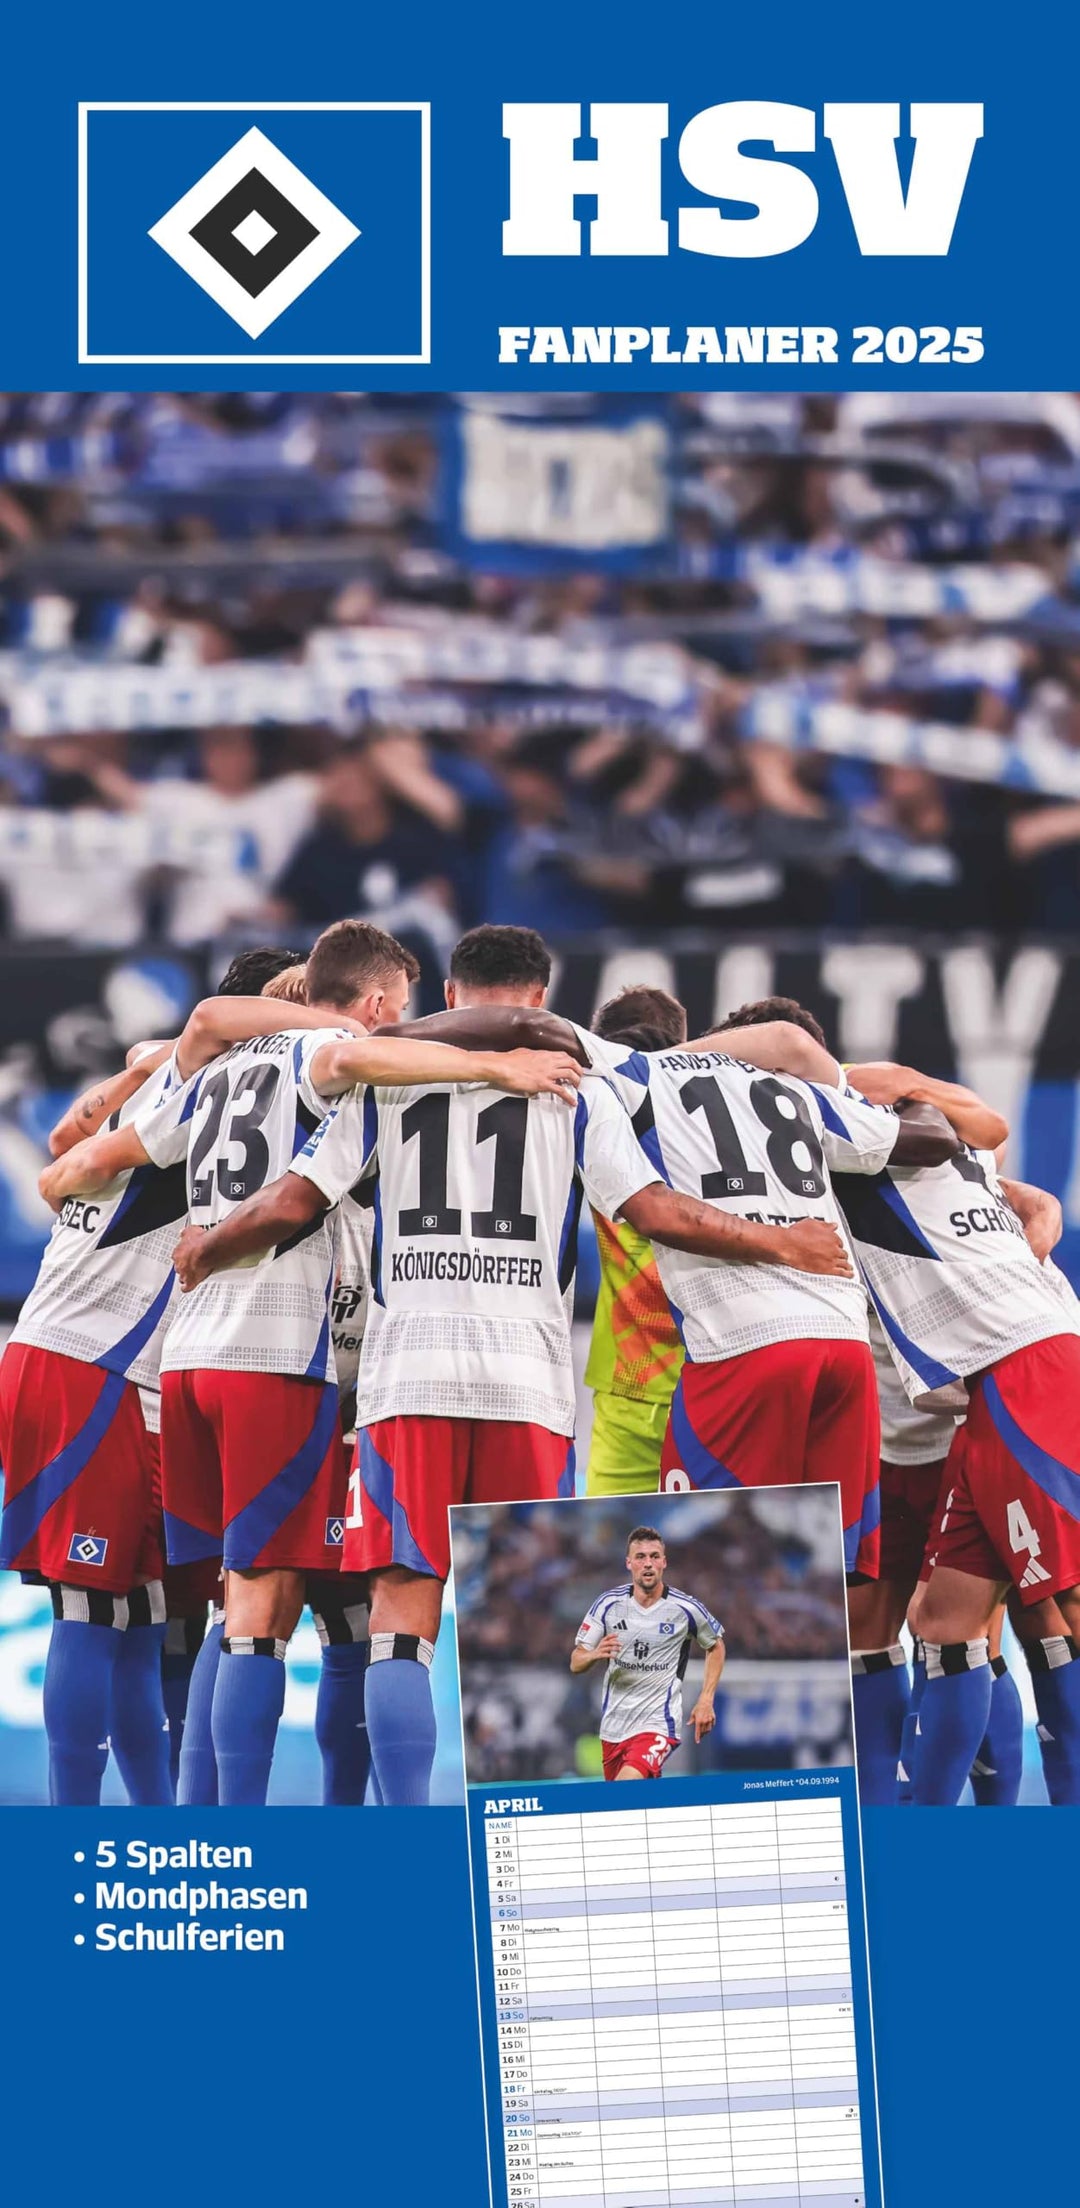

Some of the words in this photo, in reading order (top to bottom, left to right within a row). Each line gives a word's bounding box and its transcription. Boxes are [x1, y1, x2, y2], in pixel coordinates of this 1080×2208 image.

[502, 100, 984, 259] HSV
[498, 326, 839, 363] FANPLANER
[851, 326, 985, 364] 2025
[188, 1063, 281, 1207] 23
[679, 1075, 826, 1199] 18
[398, 1092, 537, 1242] 11
[391, 1246, 543, 1289] KÖNIGSDÖRFFER
[1006, 1498, 1042, 1558] 4
[743, 1781, 764, 1790] Jonas
[765, 1779, 794, 1788] Meffert
[483, 1797, 543, 1815] APRIL
[488, 1821, 513, 1830] NAME
[96, 1841, 117, 1868] 5
[127, 1839, 252, 1875] Spalten
[504, 1865, 515, 1873] Do
[96, 1881, 308, 1917] Mondphasen
[96, 1922, 284, 1951] Schulferien
[499, 1983, 509, 1991] 11
[512, 1997, 522, 2005] Sa
[500, 2012, 511, 2020] 13
[514, 2026, 526, 2034] Mo
[502, 2041, 513, 2049] 15
[516, 2055, 525, 2063] Mi
[505, 2100, 516, 2108] 19
[508, 2144, 519, 2152] 22
[509, 2173, 521, 2181] 24
